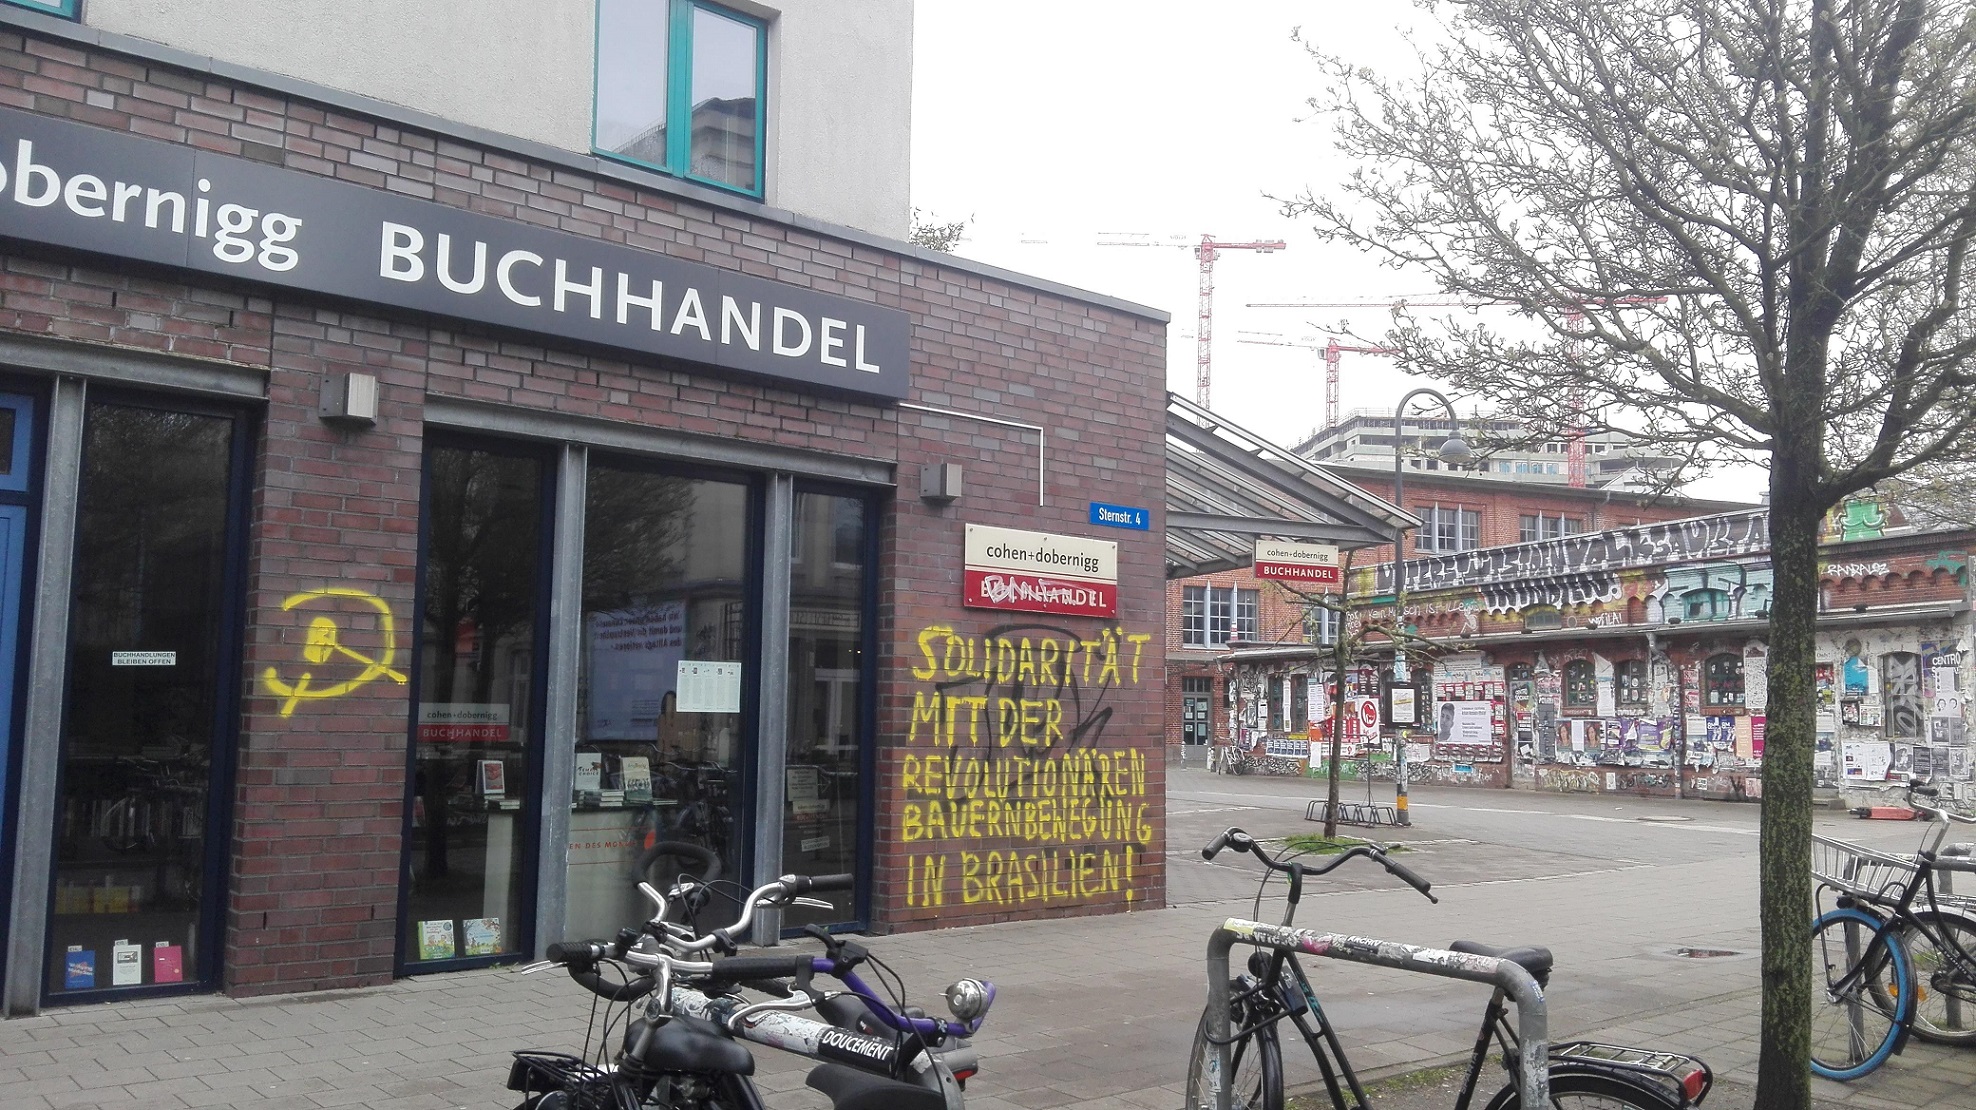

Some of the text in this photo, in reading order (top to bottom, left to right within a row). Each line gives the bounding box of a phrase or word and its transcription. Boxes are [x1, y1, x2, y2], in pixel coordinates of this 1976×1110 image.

[0, 138, 881, 375] bernigg BUCHHANDEL
[1098, 506, 1141, 525] Sternstr. 4
[986, 542, 1099, 572] cohen+dobernigg
[1266, 549, 1328, 562] cohen+dobernigg
[1264, 566, 1333, 579] BUCHHANDEL
[980, 580, 1107, 608] BHHANDEL
[912, 626, 1150, 686] SOLIDARITÄT
[1932, 652, 1960, 666] CENTRO
[423, 728, 502, 737] BUCHHANDEL
[910, 691, 1063, 748] MIT DER
[902, 748, 1146, 800] REVOLUTIONÄREN
[906, 846, 1133, 907] IN BRASILIEN!
[822, 1031, 893, 1060] DOUCEMENT
